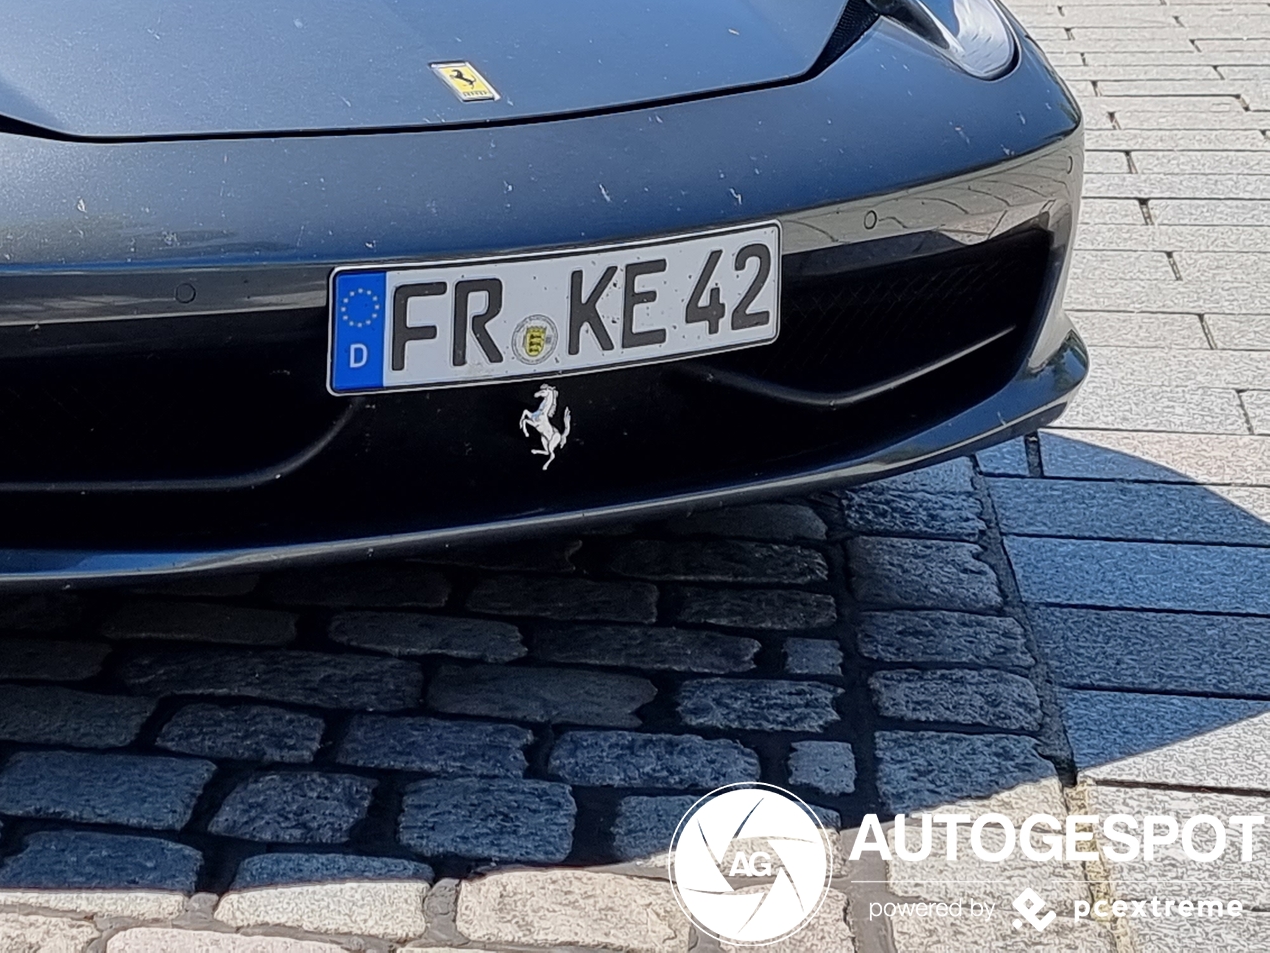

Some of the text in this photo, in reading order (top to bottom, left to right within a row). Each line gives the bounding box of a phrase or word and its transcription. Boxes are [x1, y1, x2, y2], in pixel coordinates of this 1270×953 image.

[391, 243, 771, 371] FR KE 42
[349, 343, 369, 368] D
